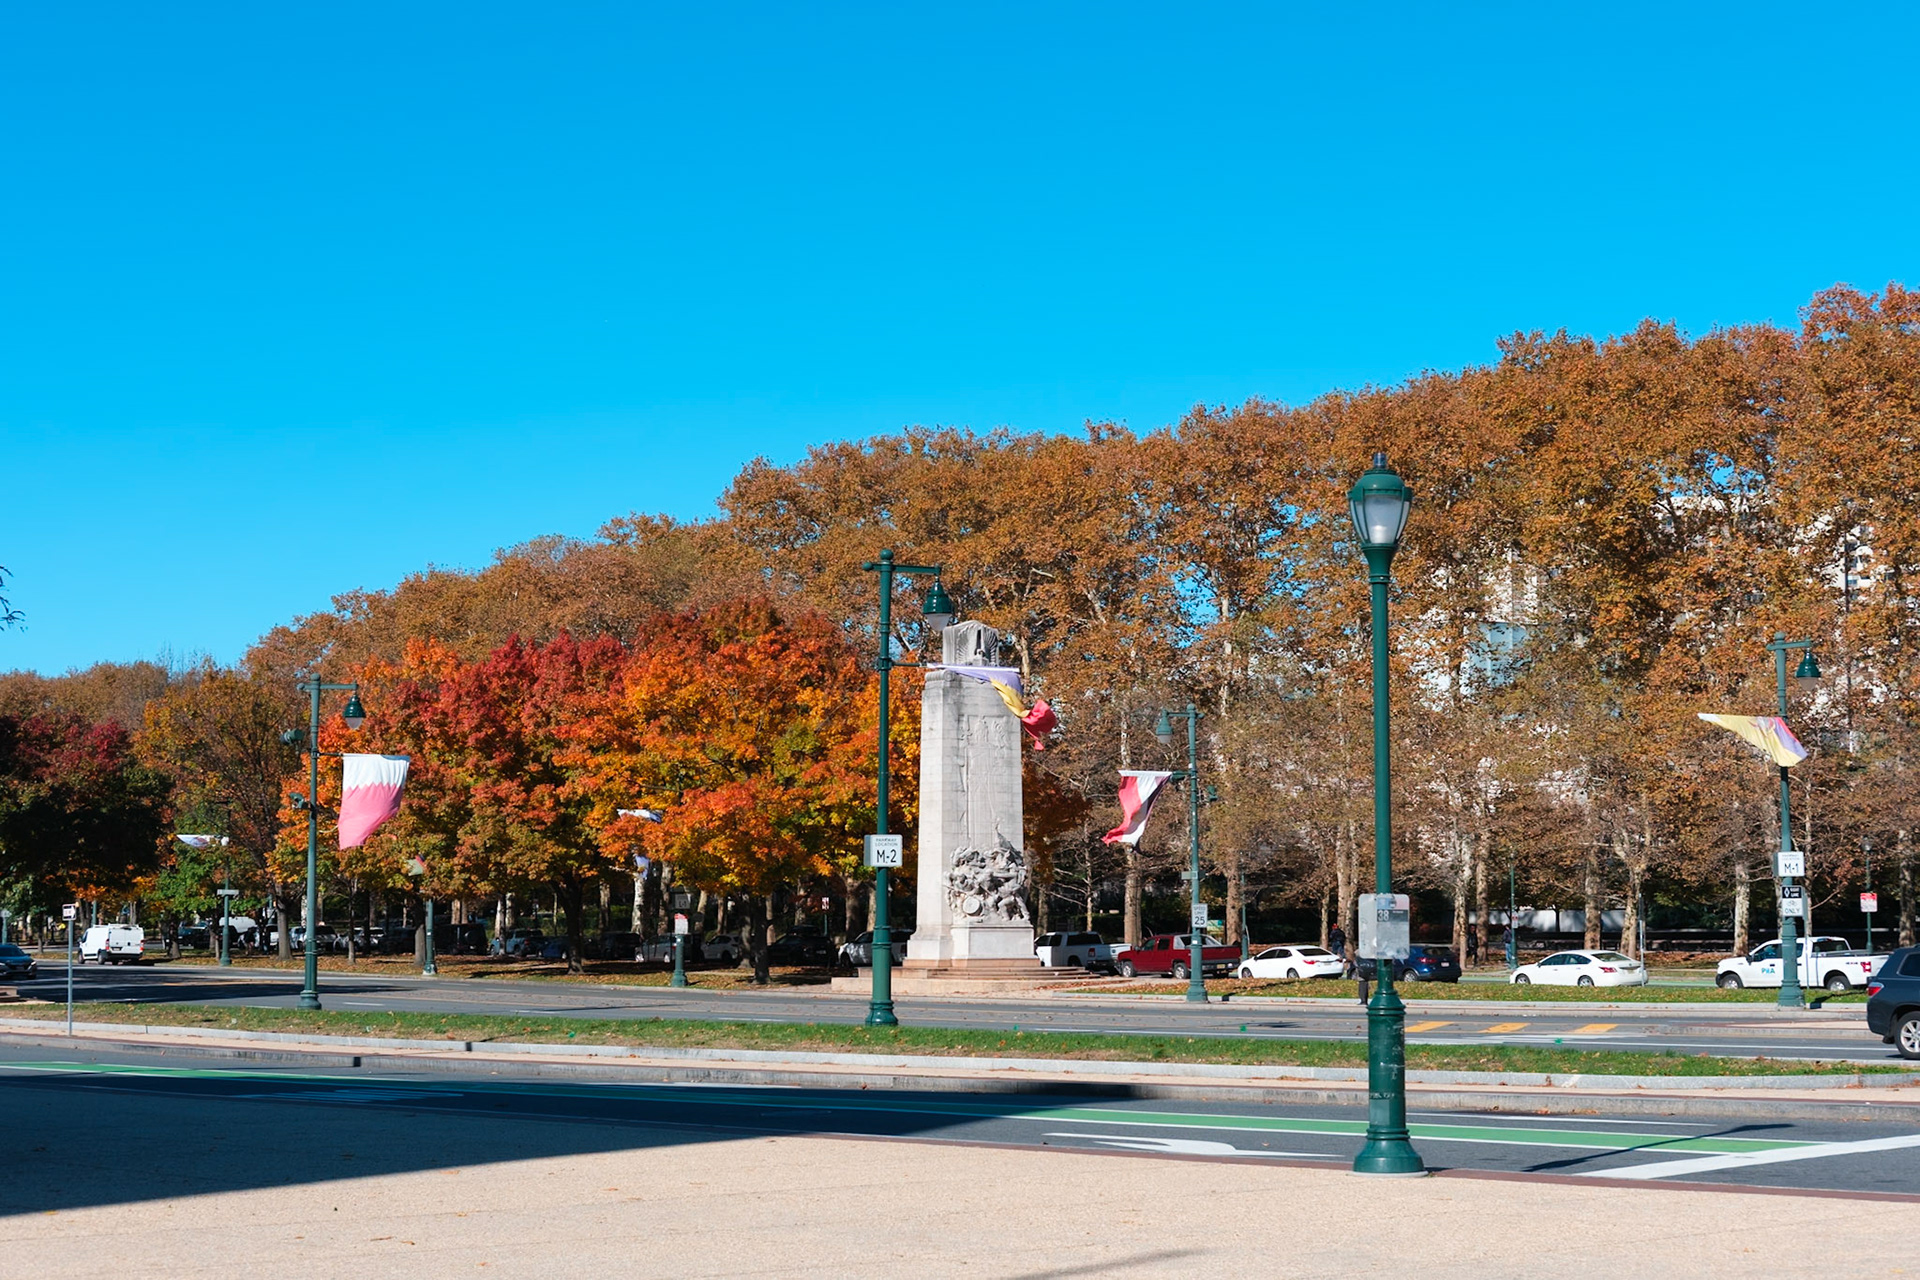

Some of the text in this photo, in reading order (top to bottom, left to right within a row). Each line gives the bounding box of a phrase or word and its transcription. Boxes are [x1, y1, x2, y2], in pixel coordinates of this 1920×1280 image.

[876, 849, 897, 863] M-2
[1784, 863, 1799, 874] M-1
[1194, 916, 1206, 925] 25
[1378, 909, 1390, 921] 38
